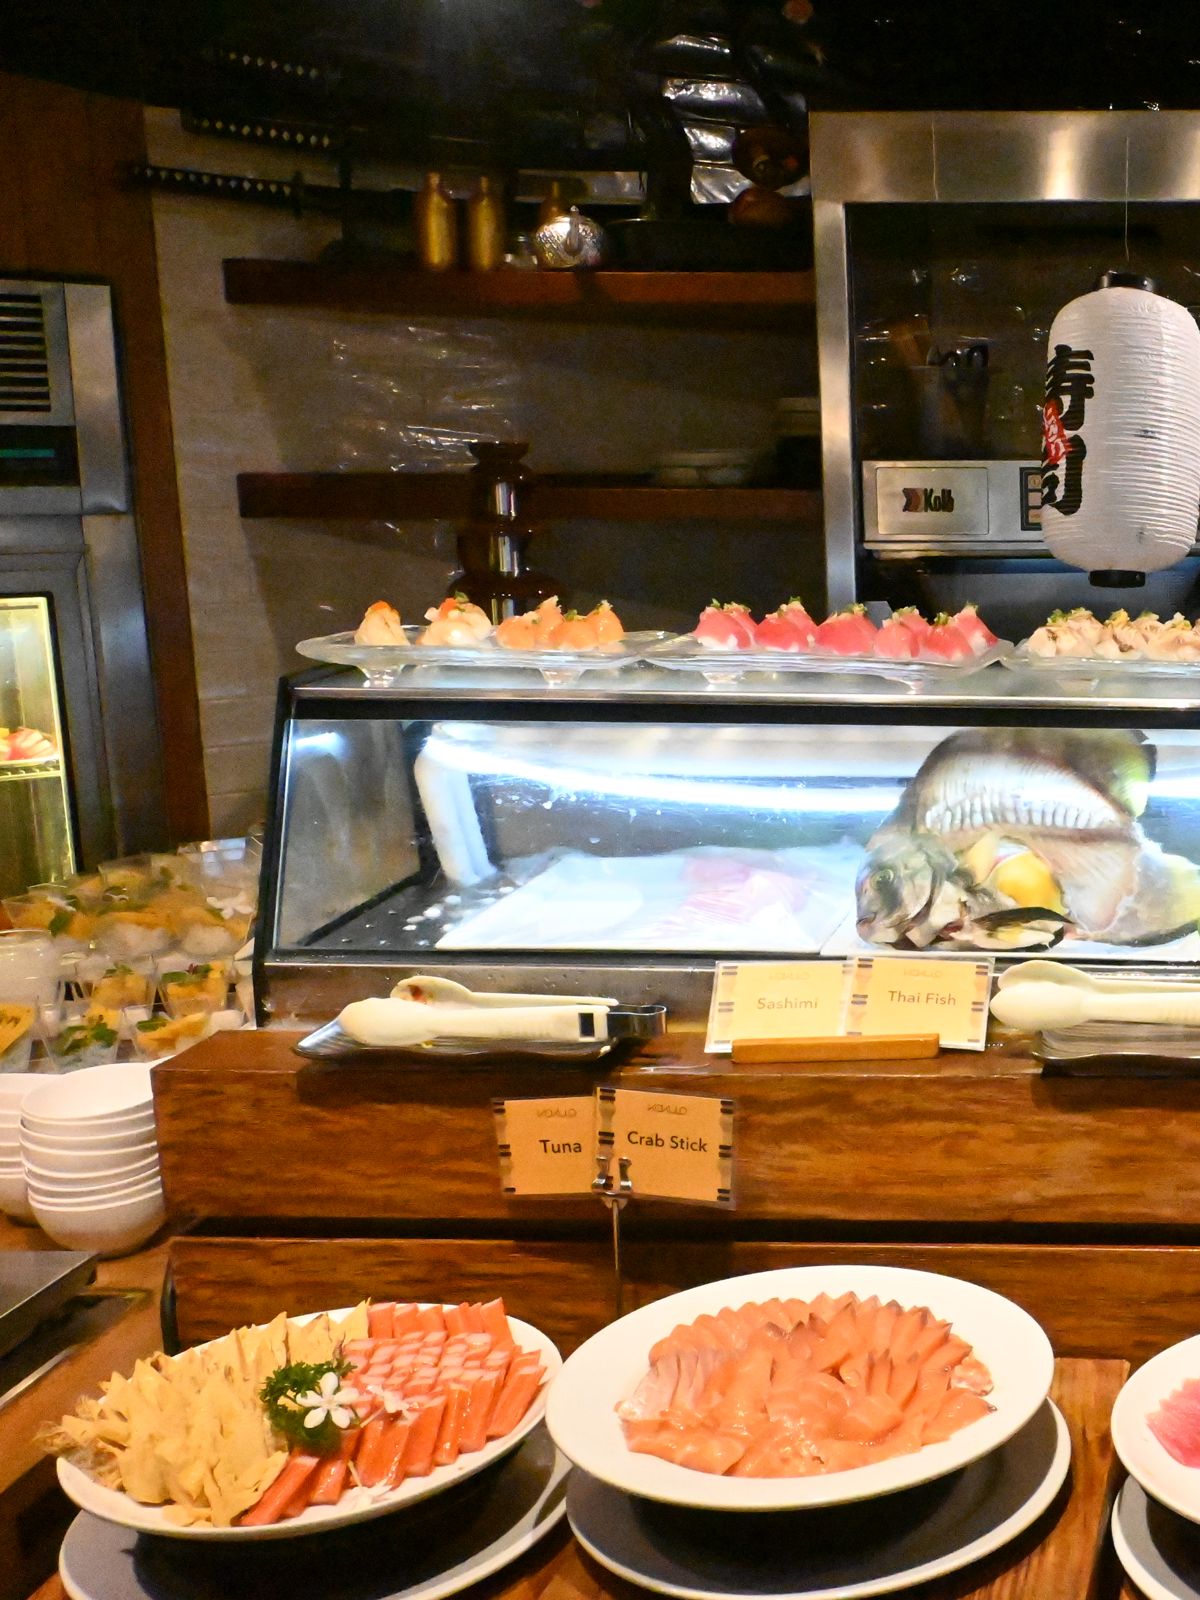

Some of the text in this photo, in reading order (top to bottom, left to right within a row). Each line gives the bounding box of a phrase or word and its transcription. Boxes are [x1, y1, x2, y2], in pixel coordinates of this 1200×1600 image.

[923, 488, 954, 512] Kolb
[757, 997, 818, 1010] Sashimi
[888, 990, 957, 1006] Thai Fish
[539, 1140, 582, 1154] Tuna
[627, 1131, 707, 1153] Crab Stick
